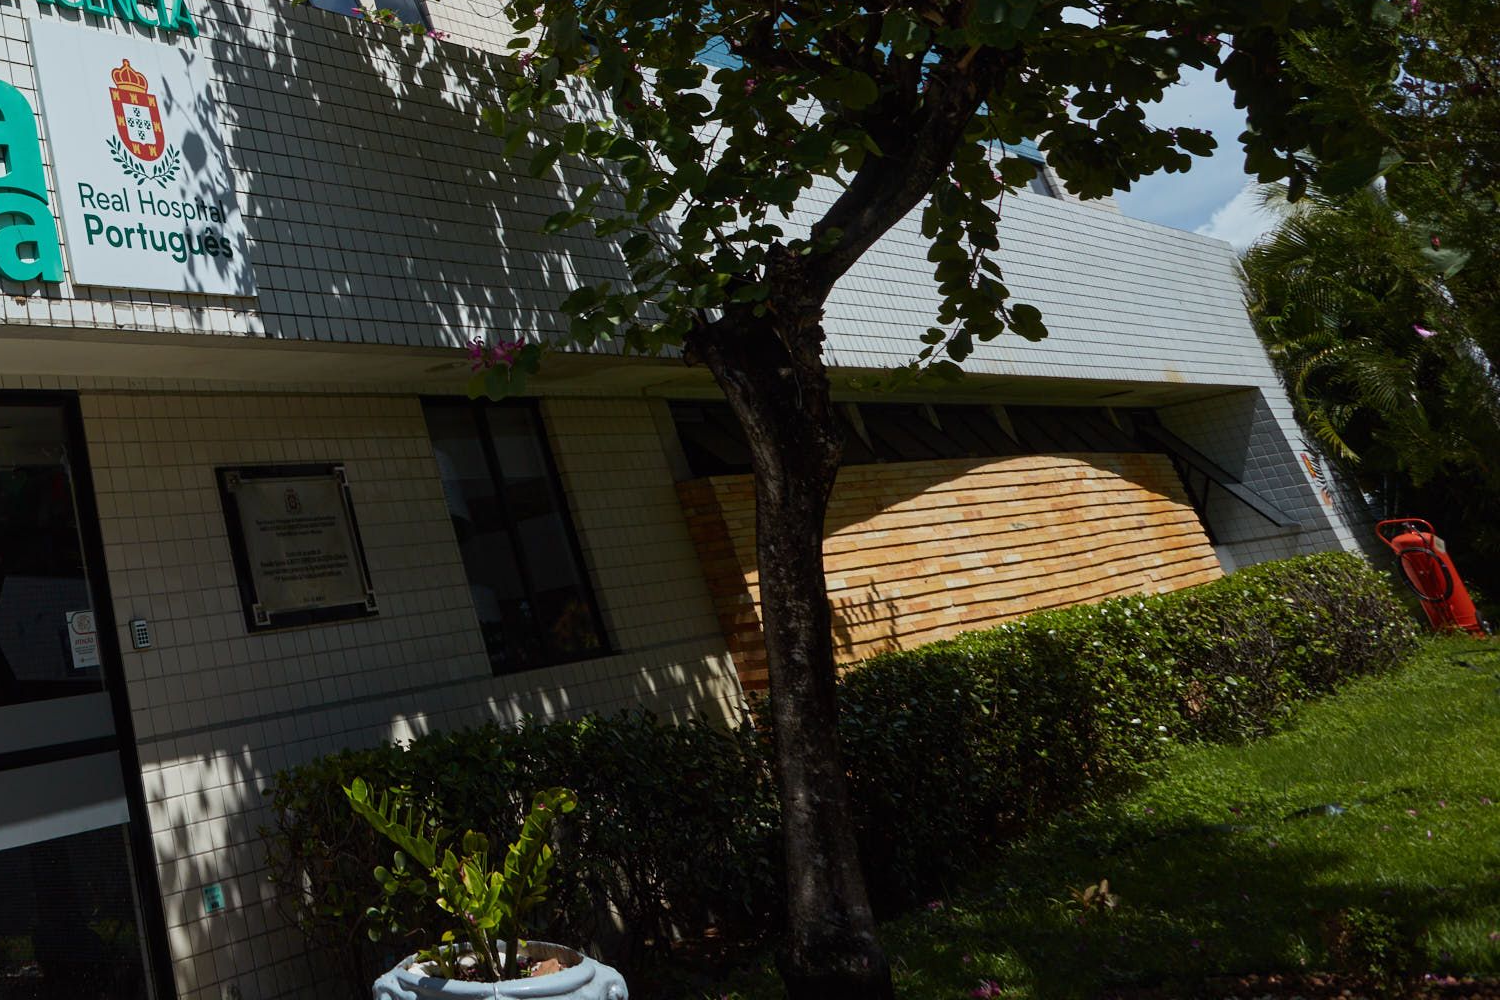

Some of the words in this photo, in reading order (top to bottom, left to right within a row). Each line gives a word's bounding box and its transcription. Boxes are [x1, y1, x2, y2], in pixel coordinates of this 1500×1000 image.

[77, 182, 131, 213] Real
[137, 189, 228, 227] Hospital
[83, 213, 234, 263] Português
